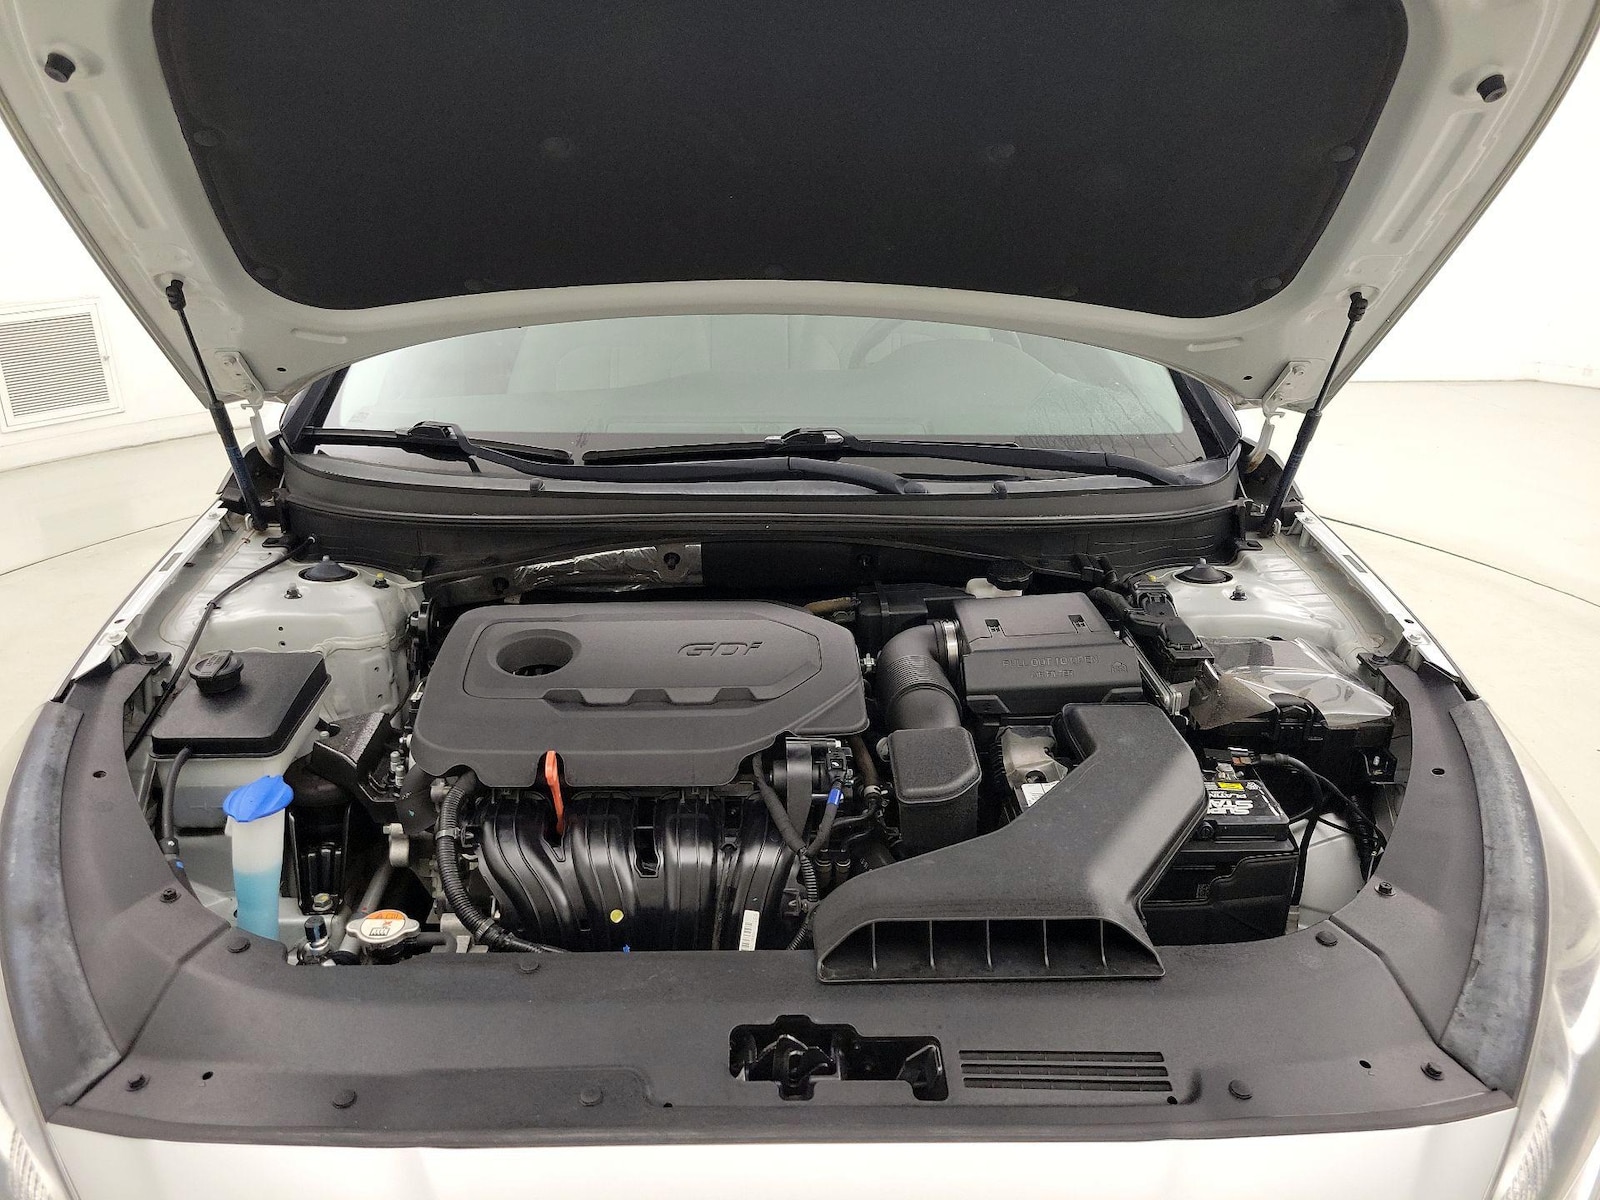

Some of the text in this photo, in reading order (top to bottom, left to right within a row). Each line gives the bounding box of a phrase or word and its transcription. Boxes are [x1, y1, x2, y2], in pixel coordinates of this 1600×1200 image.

[1002, 659, 1028, 668] PULL
[1031, 657, 1052, 667] OUT
[1055, 656, 1068, 665] TO
